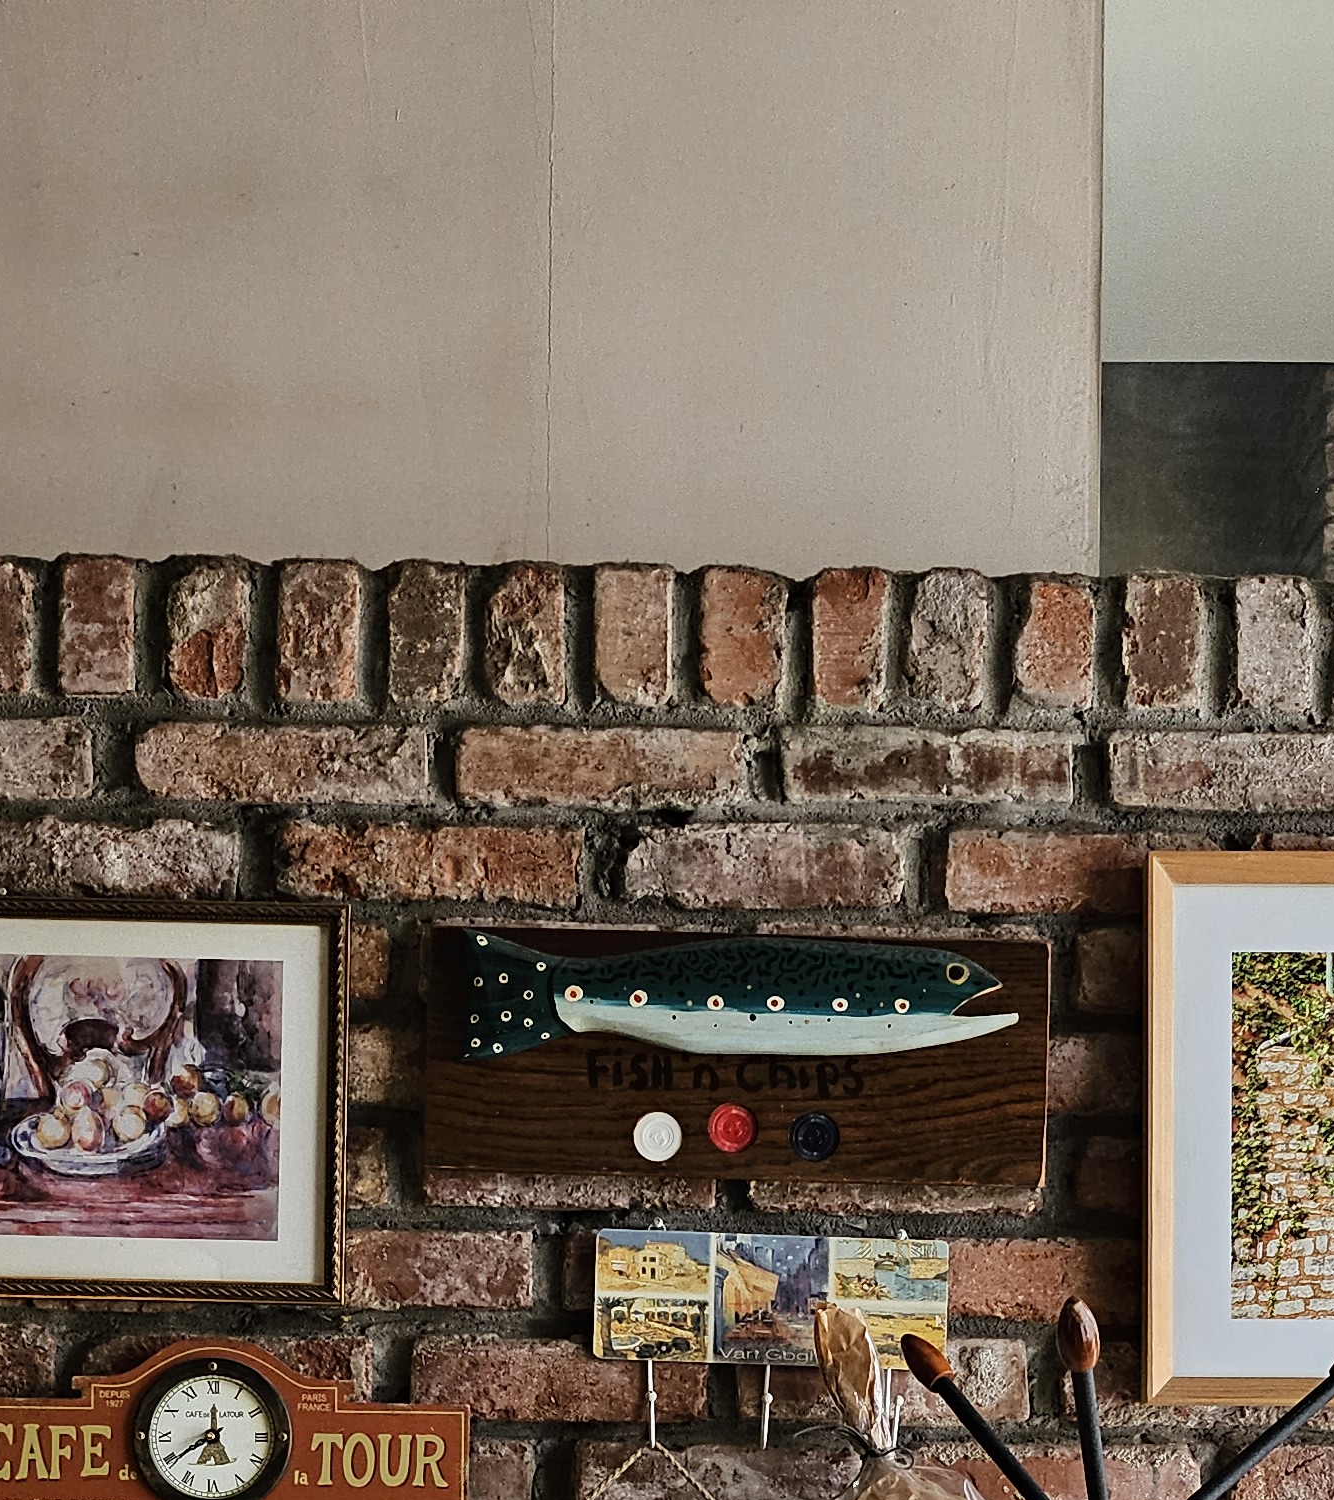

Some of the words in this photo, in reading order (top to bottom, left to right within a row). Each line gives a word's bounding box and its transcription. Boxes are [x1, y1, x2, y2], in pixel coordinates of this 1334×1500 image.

[99, 1390, 130, 1399] DEPUIS
[301, 1393, 327, 1402] PARIS
[297, 1403, 332, 1412] FRANCE
[310, 1432, 449, 1489] TOUR
